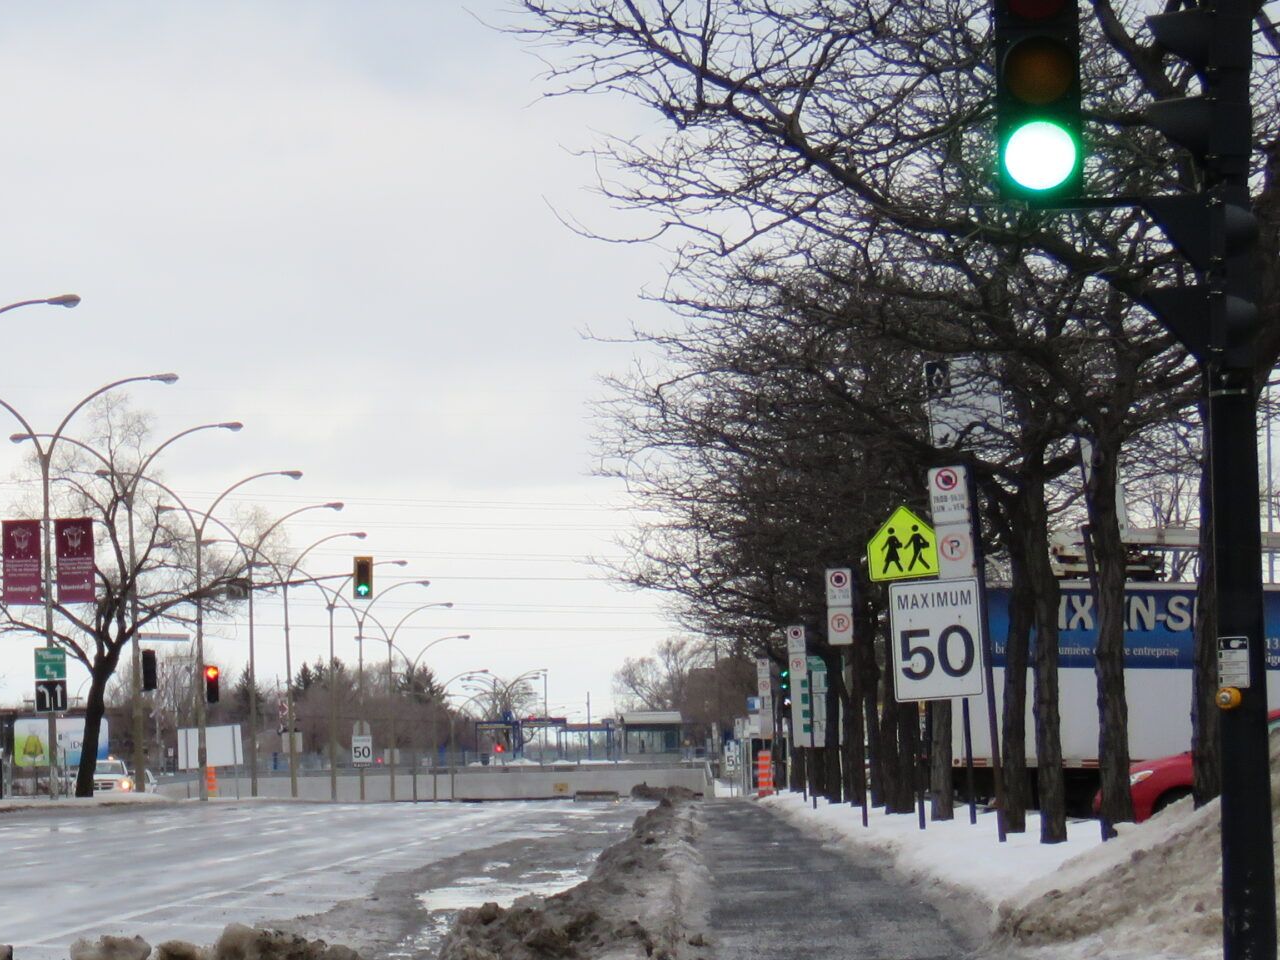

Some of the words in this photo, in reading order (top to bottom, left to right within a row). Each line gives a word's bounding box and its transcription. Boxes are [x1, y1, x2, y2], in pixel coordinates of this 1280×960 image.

[897, 589, 972, 610] MAXIMUM
[900, 624, 975, 681] 50
[1058, 642, 1090, 655] umière
[1133, 643, 1179, 657] entreprise
[353, 746, 370, 758] 50
